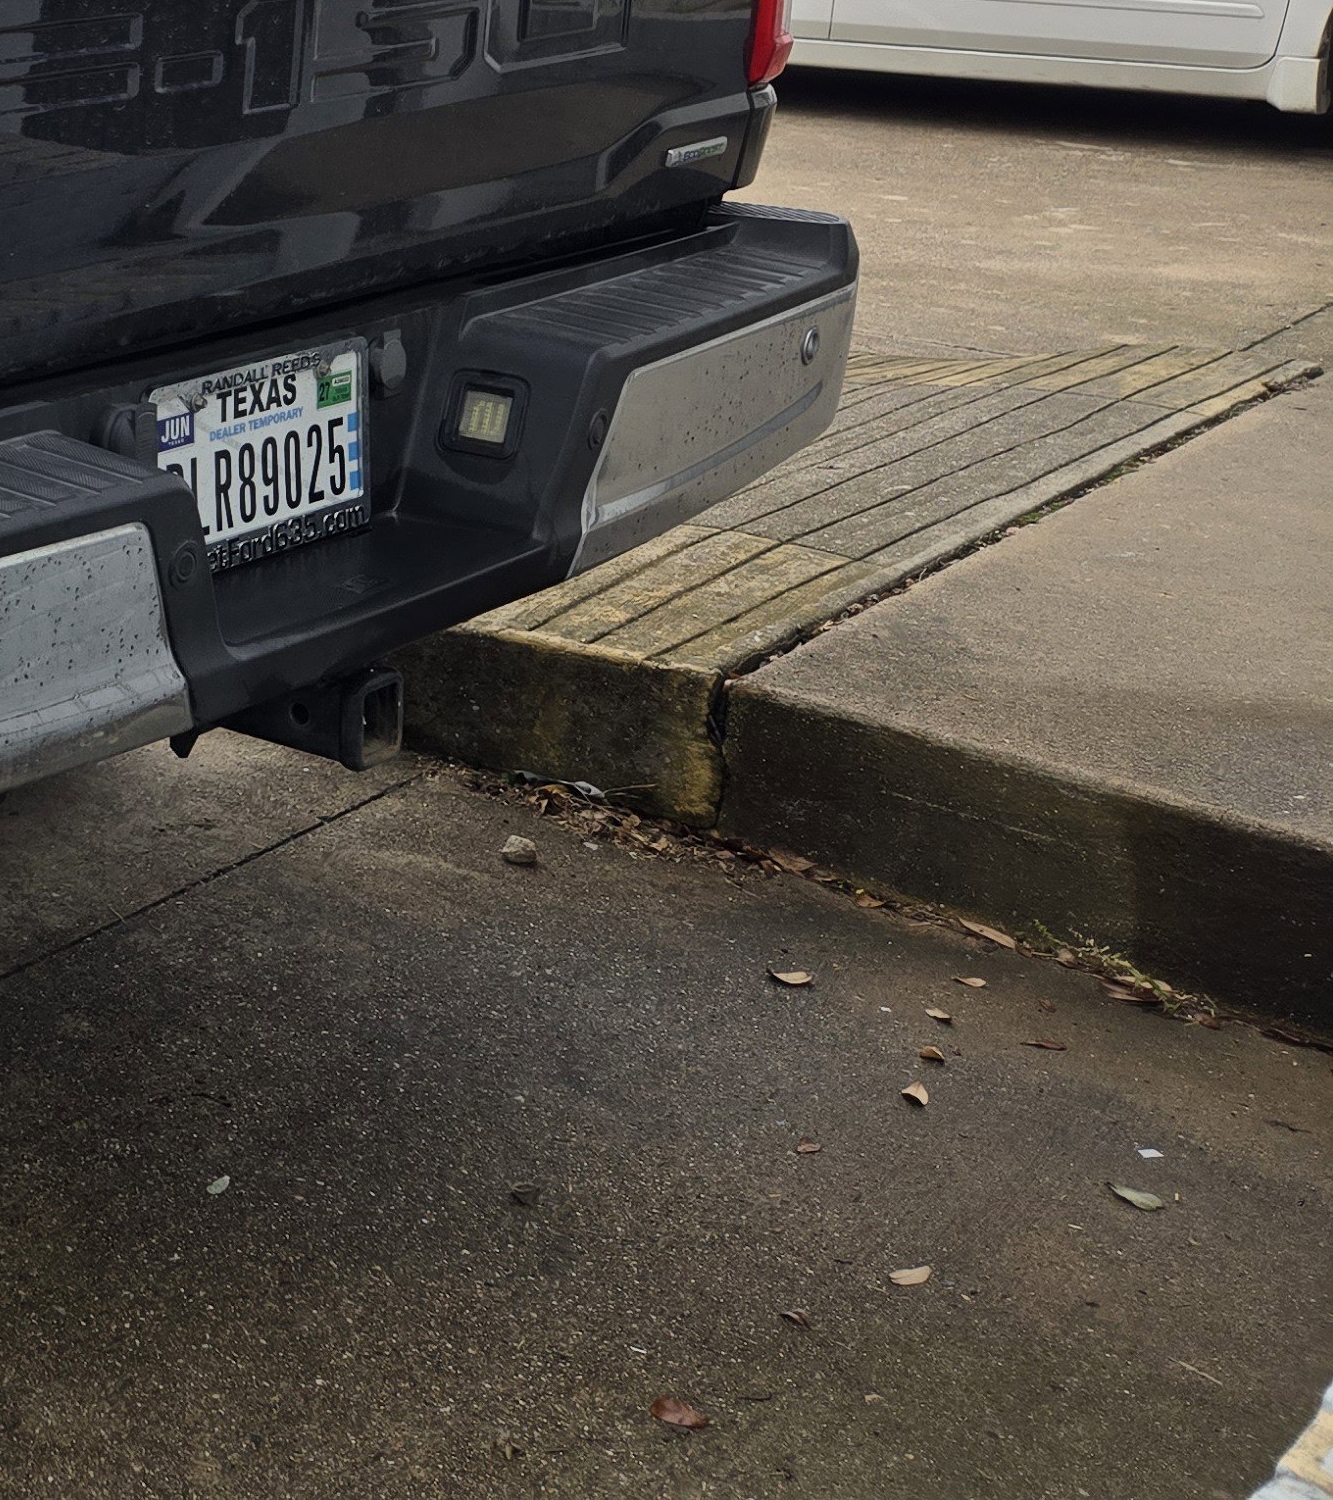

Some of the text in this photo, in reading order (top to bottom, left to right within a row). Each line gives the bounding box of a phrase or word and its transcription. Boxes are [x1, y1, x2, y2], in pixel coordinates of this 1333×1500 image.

[201, 364, 269, 395] RANDALL
[318, 381, 330, 401] 27
[216, 373, 297, 423] TEXAS
[161, 415, 190, 443] JUN
[209, 406, 304, 442] DEALER TEMPORARY
[166, 416, 346, 536] LR89025
